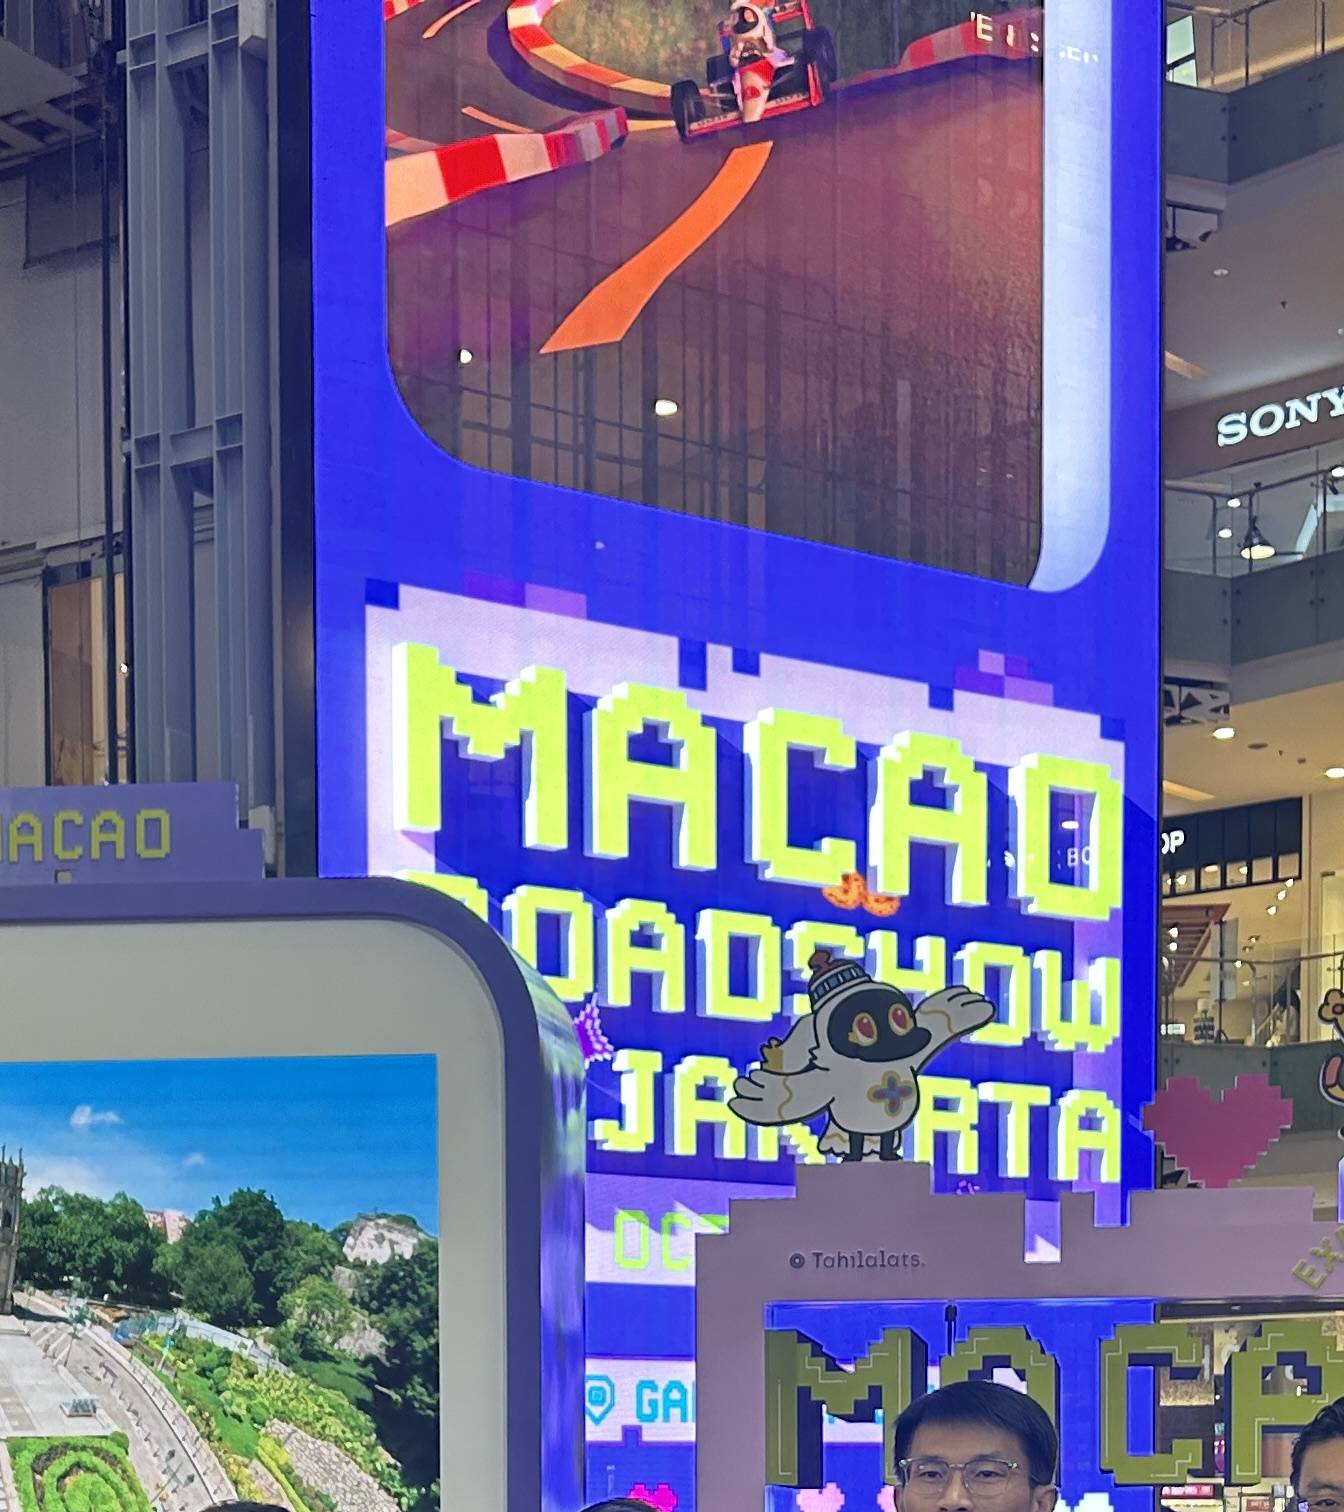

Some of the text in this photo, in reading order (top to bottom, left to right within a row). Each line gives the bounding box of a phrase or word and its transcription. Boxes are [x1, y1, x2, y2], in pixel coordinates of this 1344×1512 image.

[392, 641, 1124, 921] MACAO
[594, 1050, 1122, 1182] JARTA
[613, 1209, 729, 1272] OC
[635, 1379, 696, 1424] GA
